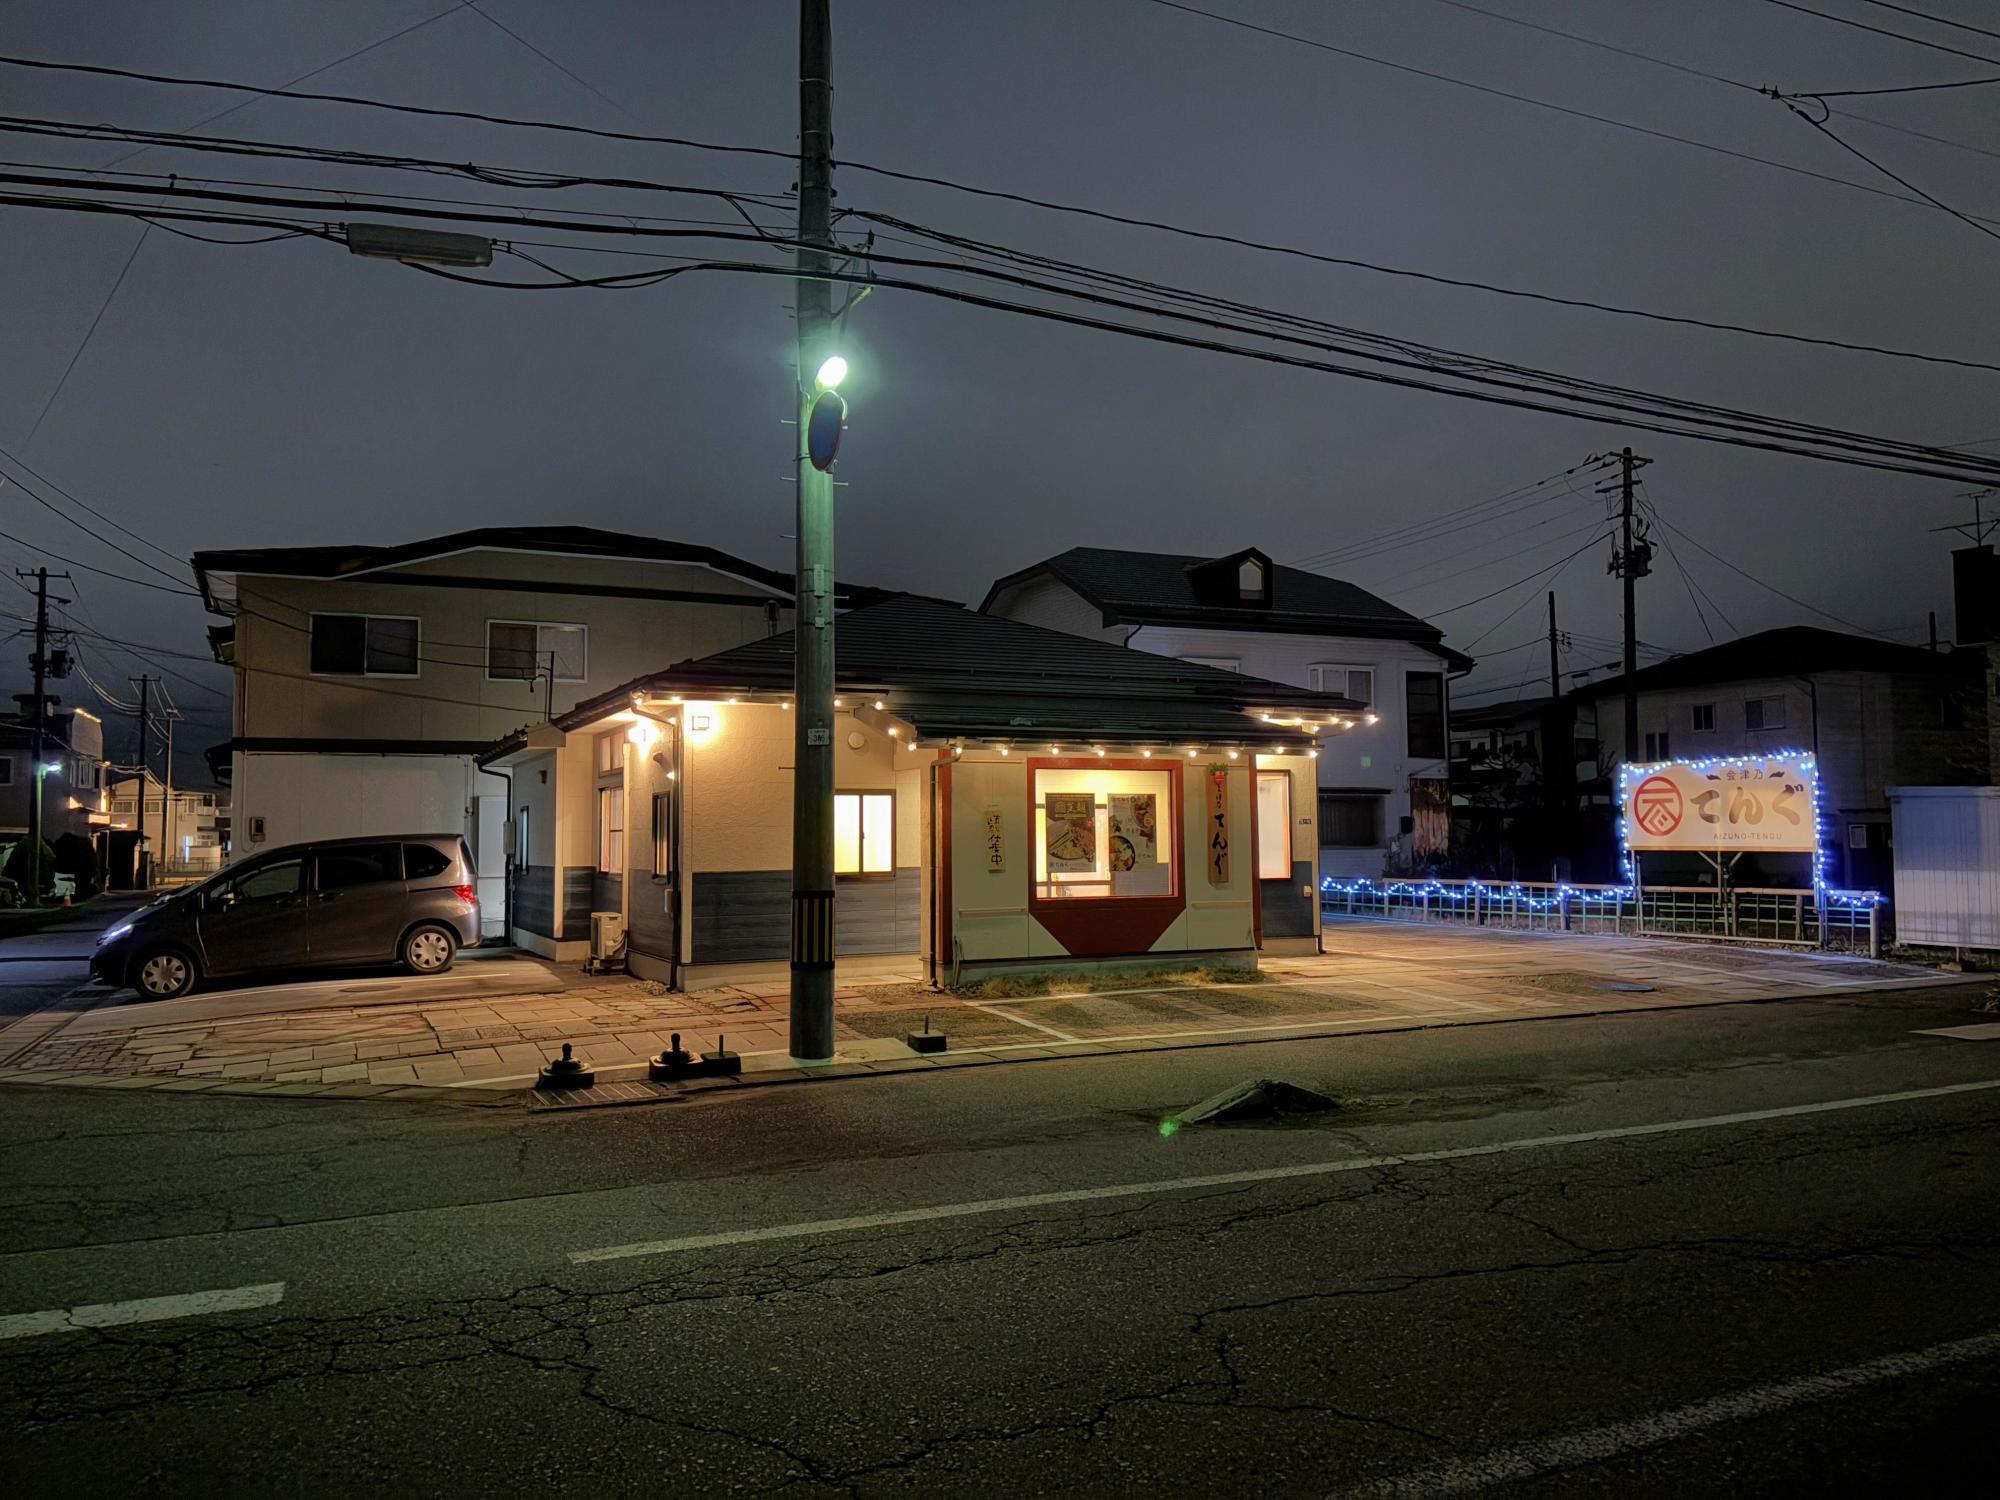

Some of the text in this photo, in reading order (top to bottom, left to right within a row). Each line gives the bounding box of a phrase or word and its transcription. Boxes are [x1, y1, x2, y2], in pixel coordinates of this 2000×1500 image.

[1726, 769, 1763, 780] 会津乃
[1690, 784, 1804, 825] てんぐ
